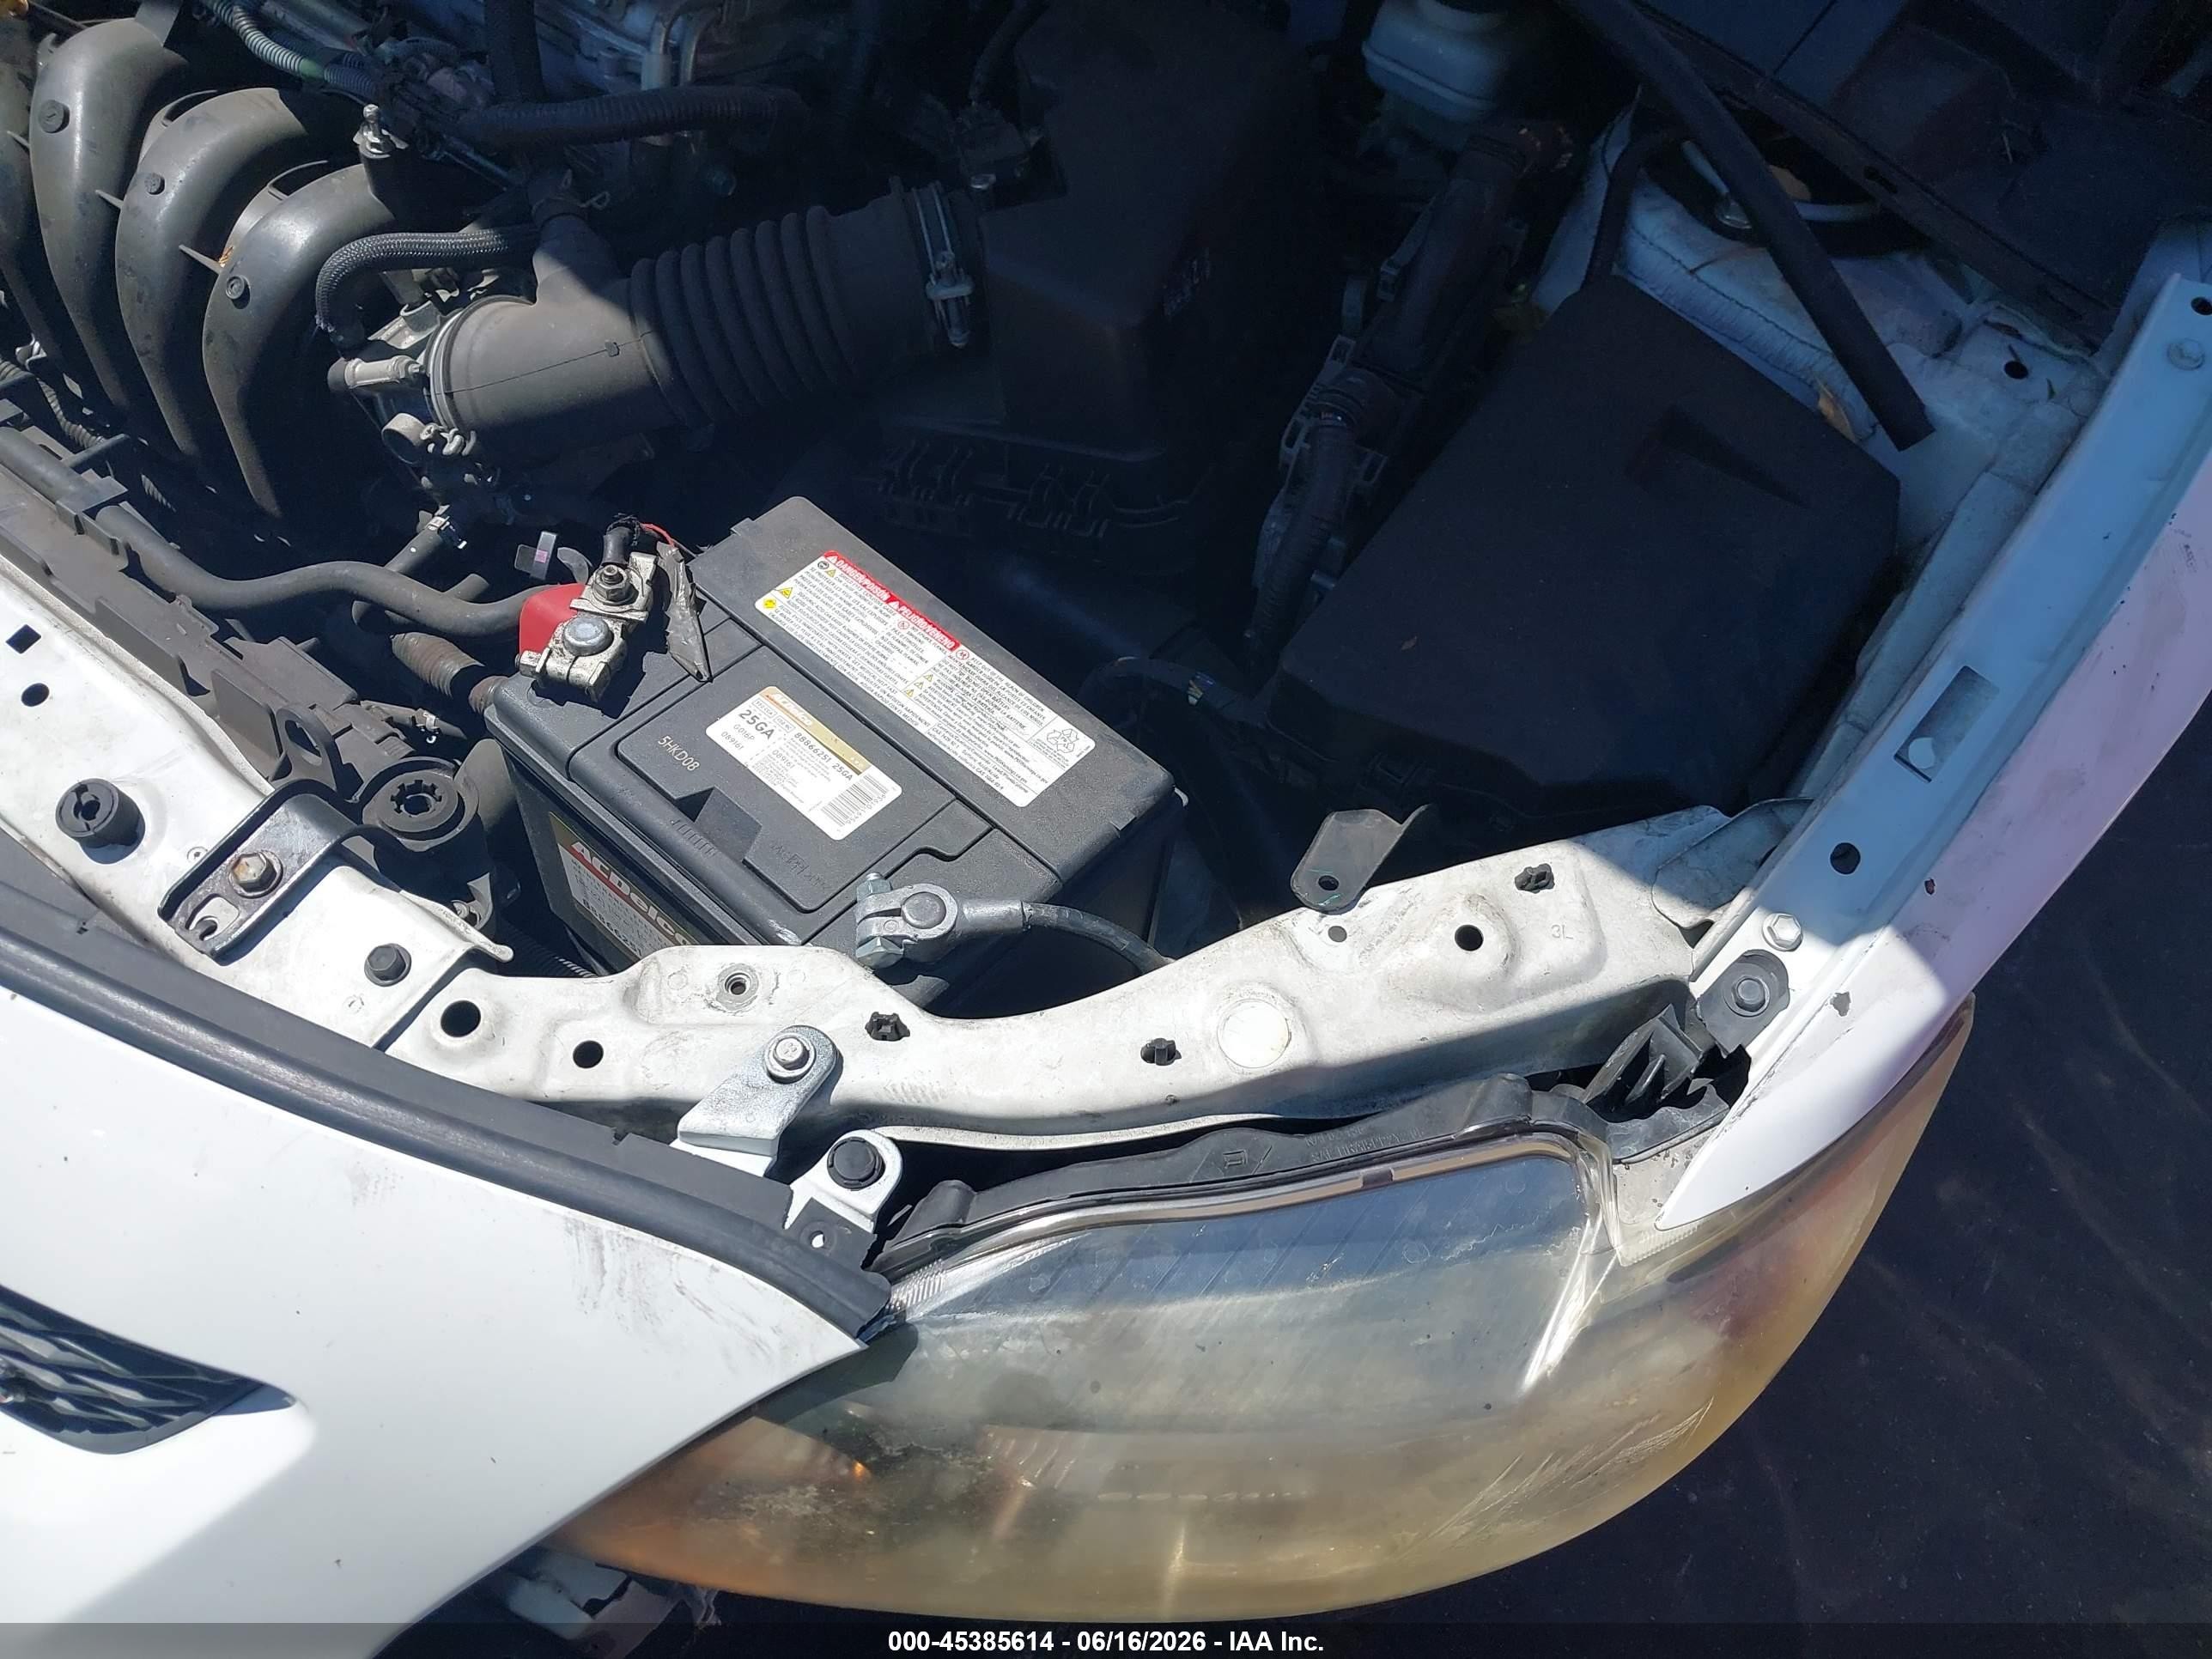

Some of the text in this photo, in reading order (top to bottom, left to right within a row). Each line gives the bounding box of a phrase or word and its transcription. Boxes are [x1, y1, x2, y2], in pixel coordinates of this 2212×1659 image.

[896, 605, 957, 648] PELIGRO/VENENO
[736, 708, 778, 739] 25GA
[658, 736, 700, 771] 5HKD08
[770, 749, 796, 769] 089161
[792, 732, 833, 763] 88866251
[830, 762, 854, 781] 25GA
[569, 841, 695, 945] ACDelco
[1551, 924, 1573, 940] 3L
